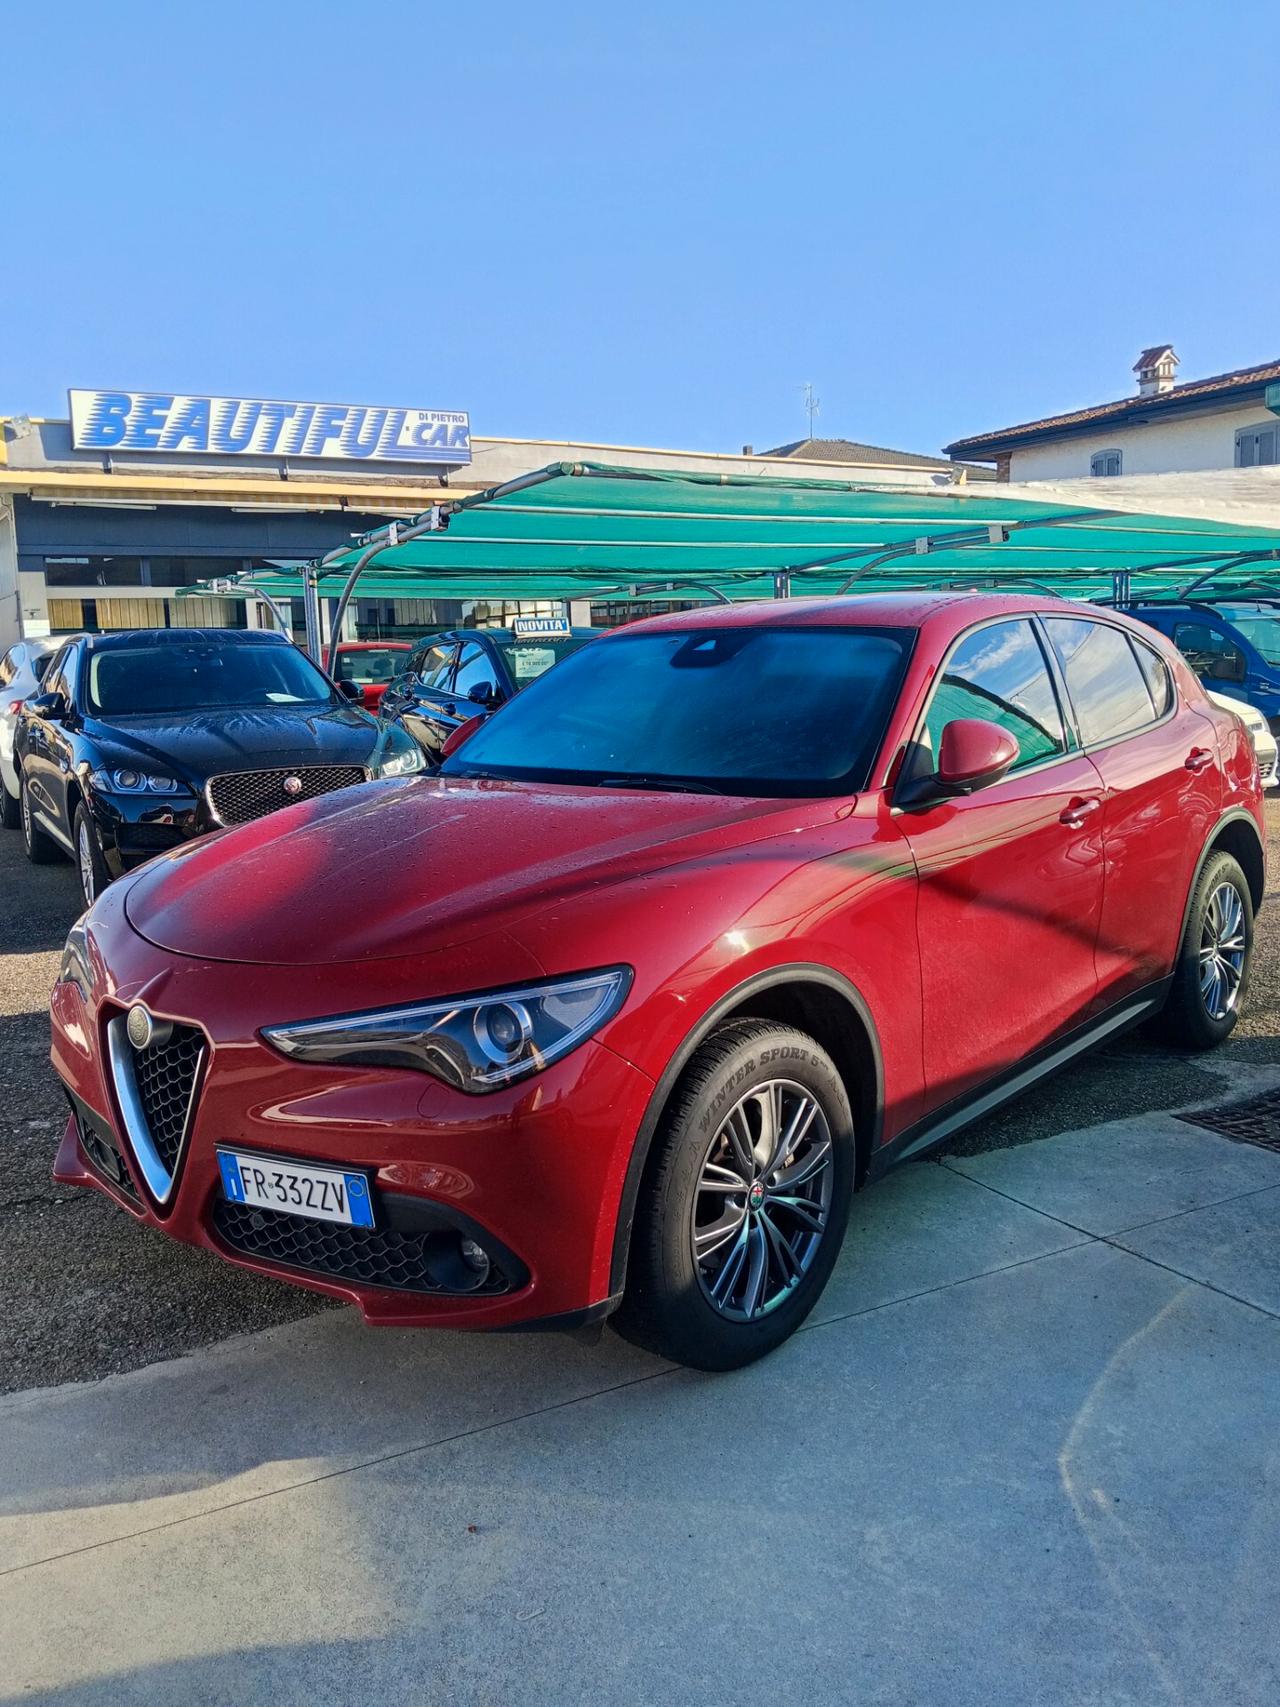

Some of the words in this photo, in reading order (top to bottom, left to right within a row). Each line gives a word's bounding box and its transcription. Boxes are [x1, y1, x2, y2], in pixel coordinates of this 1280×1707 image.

[79, 393, 409, 458] BEAUTIFUL
[412, 423, 469, 447] CAR
[418, 412, 429, 421] DI
[431, 413, 465, 423] PIETRO
[700, 1059, 756, 1132] WINTER
[760, 1046, 809, 1066] SPORT
[810, 1055, 820, 1067] 5
